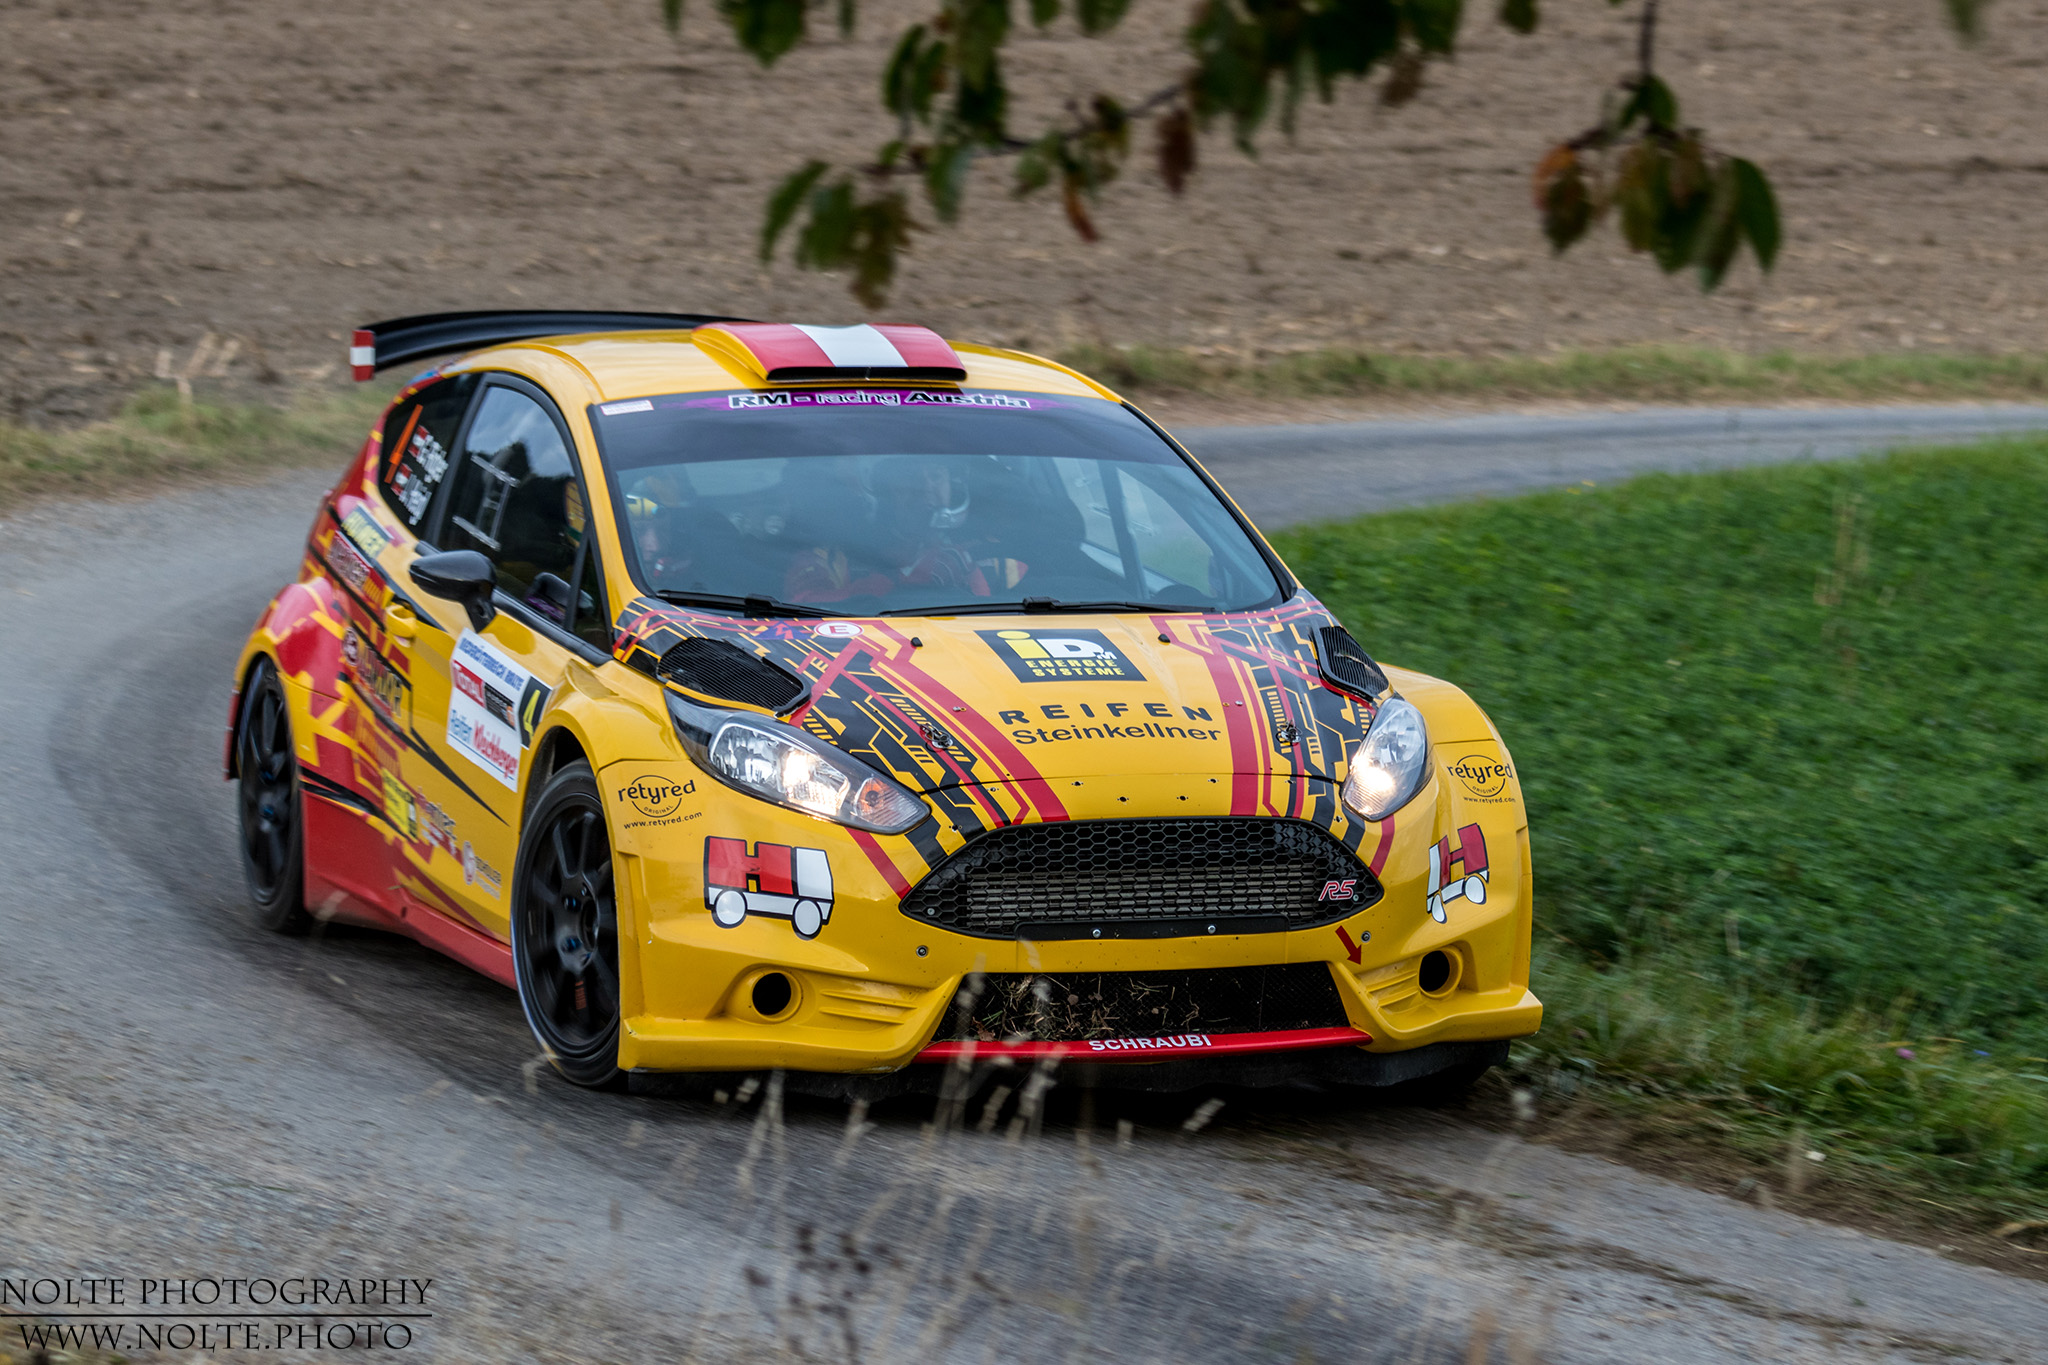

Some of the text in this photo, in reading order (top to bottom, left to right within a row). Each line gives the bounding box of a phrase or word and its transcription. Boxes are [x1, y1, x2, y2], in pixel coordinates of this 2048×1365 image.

[728, 392, 791, 408] RM
[815, 390, 900, 406] racing
[904, 391, 1031, 408] Austria
[1025, 659, 1117, 668] ENERGIE
[1031, 667, 1125, 677] SYSTEME
[523, 689, 541, 742] 4
[998, 703, 1213, 725] REIFEN
[1012, 723, 1221, 745] Steinkellner
[1447, 763, 1513, 784] retyred
[618, 780, 696, 804] retyred
[643, 805, 673, 814] ORIGINAL
[624, 812, 702, 829] www.retyred.com
[1088, 1034, 1212, 1051] SCHRAUBI
